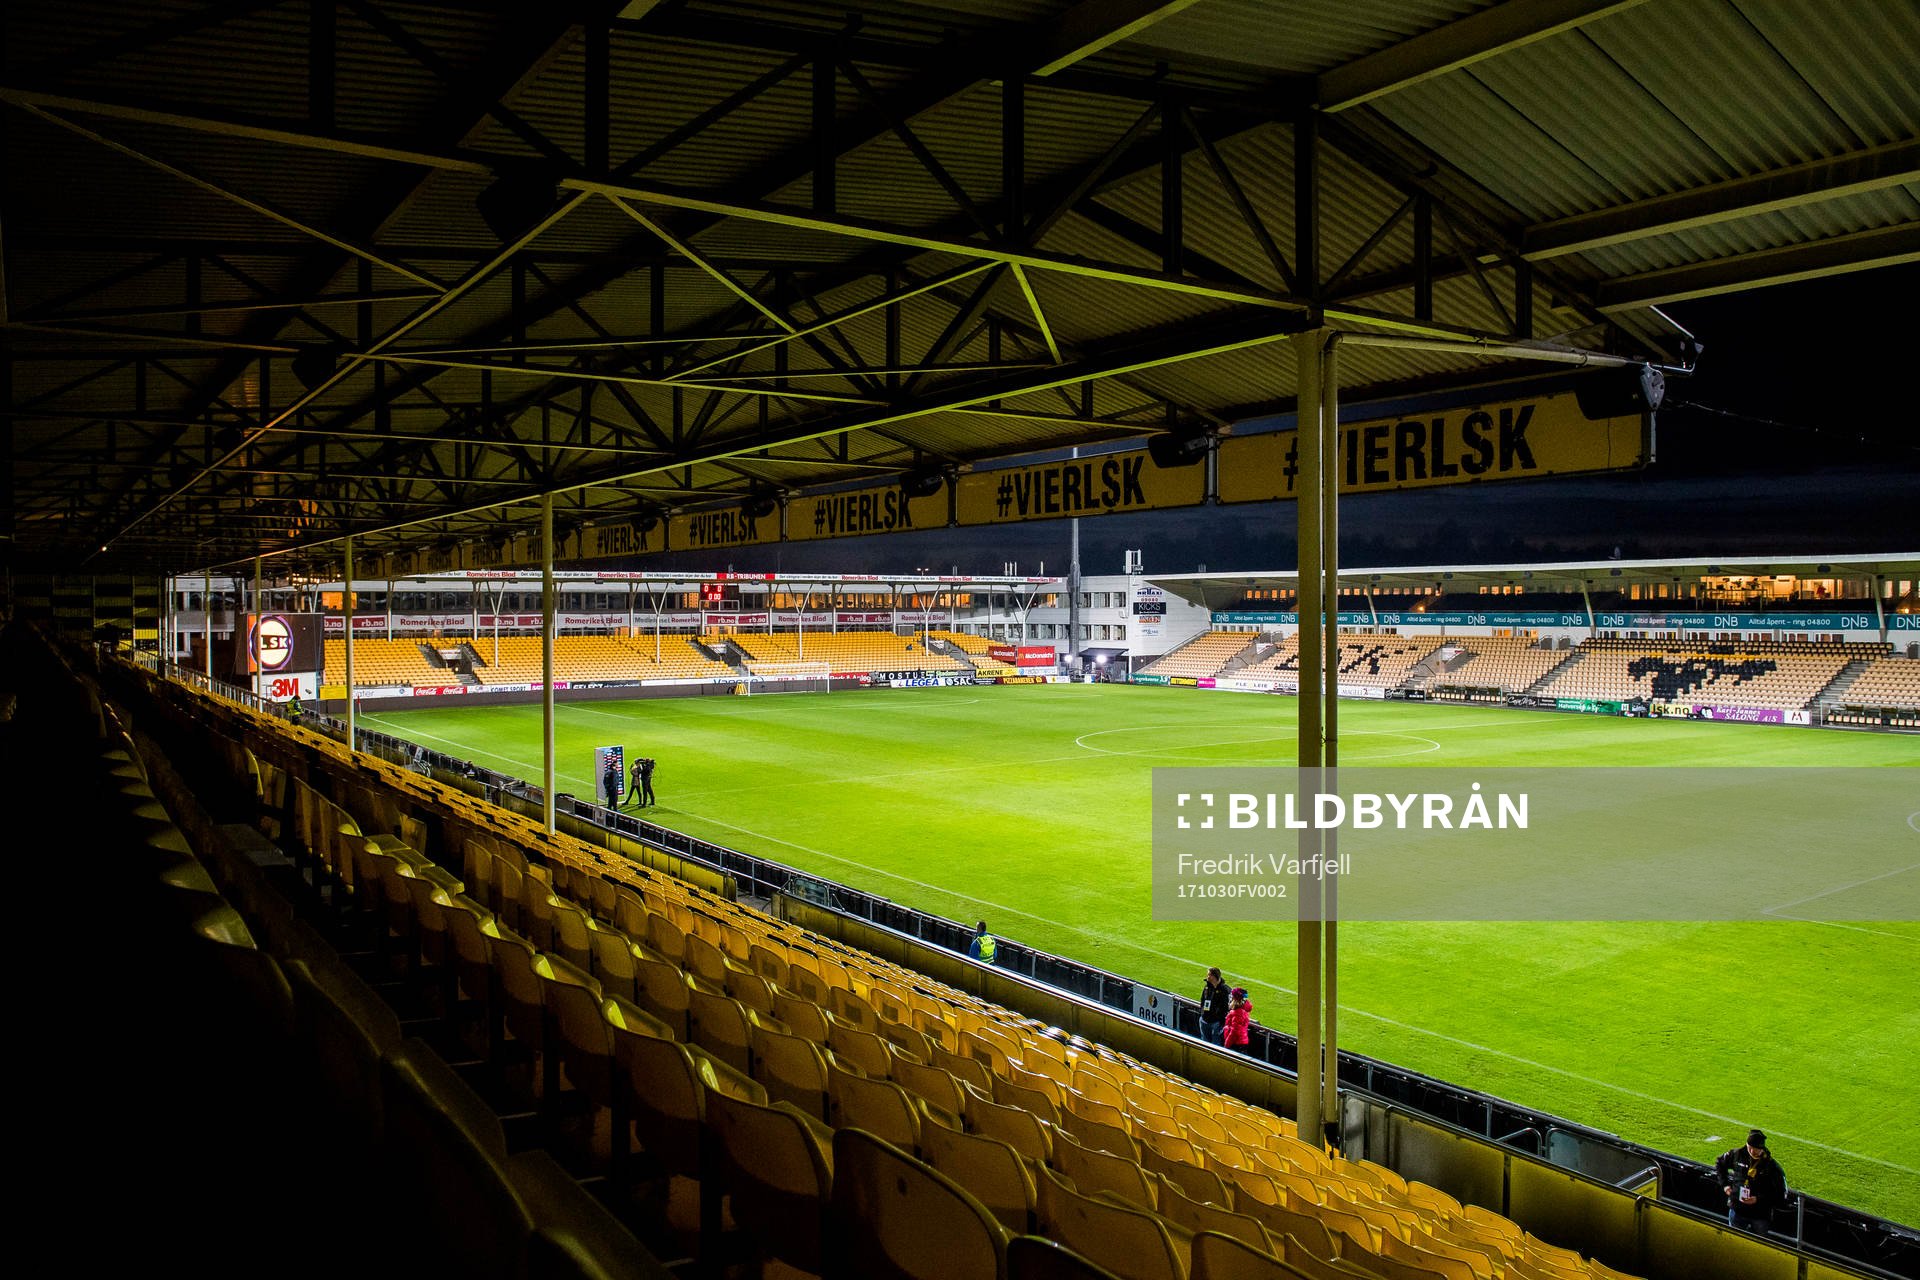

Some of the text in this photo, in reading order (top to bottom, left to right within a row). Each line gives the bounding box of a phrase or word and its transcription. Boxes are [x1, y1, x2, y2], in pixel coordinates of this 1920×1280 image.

[1283, 405, 1537, 491] #IERLSK
[996, 456, 1146, 517] #VIERLSK
[815, 490, 912, 534] #VIERLSK
[689, 512, 757, 545] #VIERLSK
[1139, 602, 1161, 611] KICKS
[361, 618, 384, 627] rb.no
[400, 617, 465, 626] Romerikes Blad
[565, 616, 623, 625] Romerikes Blad
[717, 616, 735, 624] rb.no
[1216, 613, 1229, 623] DNB
[1281, 613, 1296, 624] DNB
[1353, 613, 1369, 624] DNB
[1384, 613, 1400, 625] DNB
[1468, 614, 1486, 626] DNB
[1562, 614, 1582, 627] DNB
[1603, 614, 1624, 627] DNB
[1649, 617, 1666, 625] åpent
[1714, 614, 1738, 628] DNB
[1749, 617, 1766, 625] Alltid
[1766, 617, 1786, 626] åpent
[1793, 618, 1806, 626] ring
[1841, 614, 1868, 630] DNB
[261, 637, 288, 649] LSK
[977, 669, 1003, 677] AKRENE
[272, 678, 299, 697] 3M
[905, 678, 939, 687] LEGEA
[1653, 704, 1689, 715] lsk.no
[1725, 713, 1759, 721] SALONG
[1139, 1006, 1167, 1026] ARKEL
